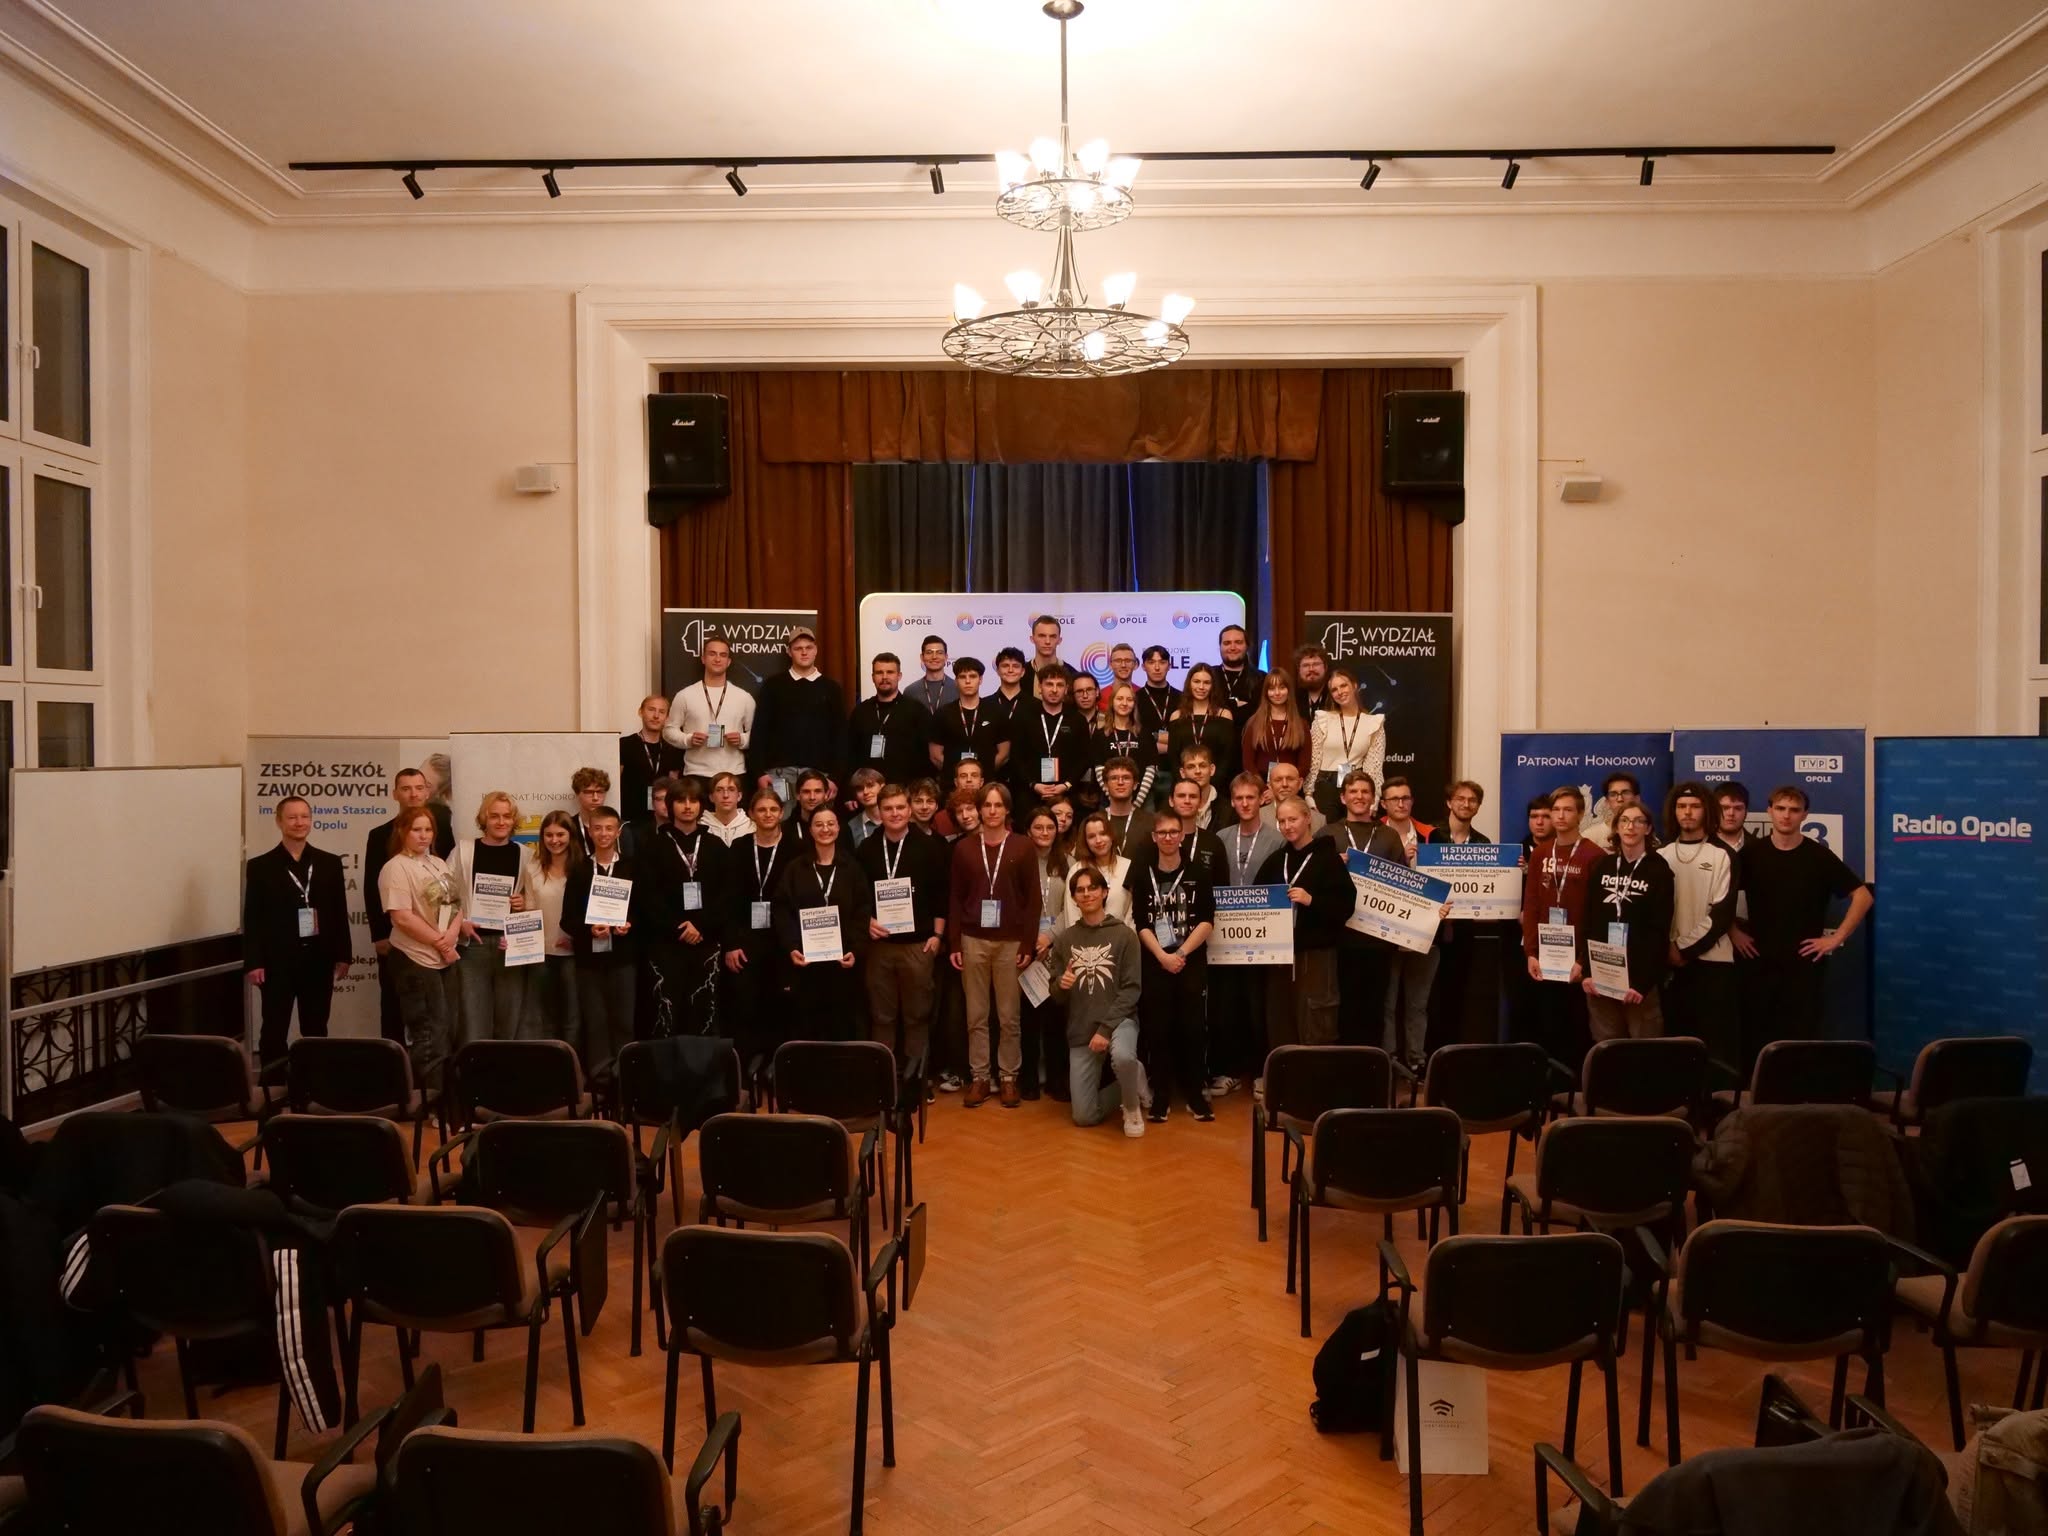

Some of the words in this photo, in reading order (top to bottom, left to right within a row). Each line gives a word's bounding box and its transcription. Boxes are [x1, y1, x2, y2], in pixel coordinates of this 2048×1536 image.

[1119, 616, 1148, 624] OPOLE
[722, 624, 796, 640] WYDZIA
[1361, 627, 1436, 643] WYDZIAŁ
[729, 642, 790, 654] NFORMATY
[1359, 646, 1436, 657] INFORMATYKI
[1517, 755, 1580, 767] PATRONAT
[1585, 754, 1656, 767] HONOROWY
[260, 761, 326, 777] ZESPÓŁ
[330, 761, 386, 777] SZKÓŁ
[1705, 774, 1731, 782] OPOLE
[1805, 775, 1832, 783] OPOLE
[257, 783, 389, 797] ZAWODOWYCH
[258, 805, 276, 815] im.
[342, 805, 387, 815] Staszica
[313, 820, 348, 831] Opolu
[1892, 813, 1957, 835] Radio
[1961, 815, 2032, 842] Opole
[1440, 846, 1448, 854] III
[1449, 846, 1499, 854] STUDENCKI
[1442, 854, 1497, 862] HACKATHON
[1369, 858, 1378, 866] III
[1379, 862, 1428, 884] STUDENCKI
[1368, 865, 1424, 890] HACKATHON
[1213, 889, 1221, 897] III
[1222, 888, 1269, 897] STUDENCKI
[1453, 881, 1479, 894] 000
[1483, 881, 1494, 894] zł
[1215, 896, 1268, 905] HACKATHON
[1363, 894, 1395, 914] 1000
[1397, 908, 1412, 920] zł
[1221, 926, 1252, 939] 1000
[1255, 926, 1266, 938] zł
[346, 985, 356, 993] 51
